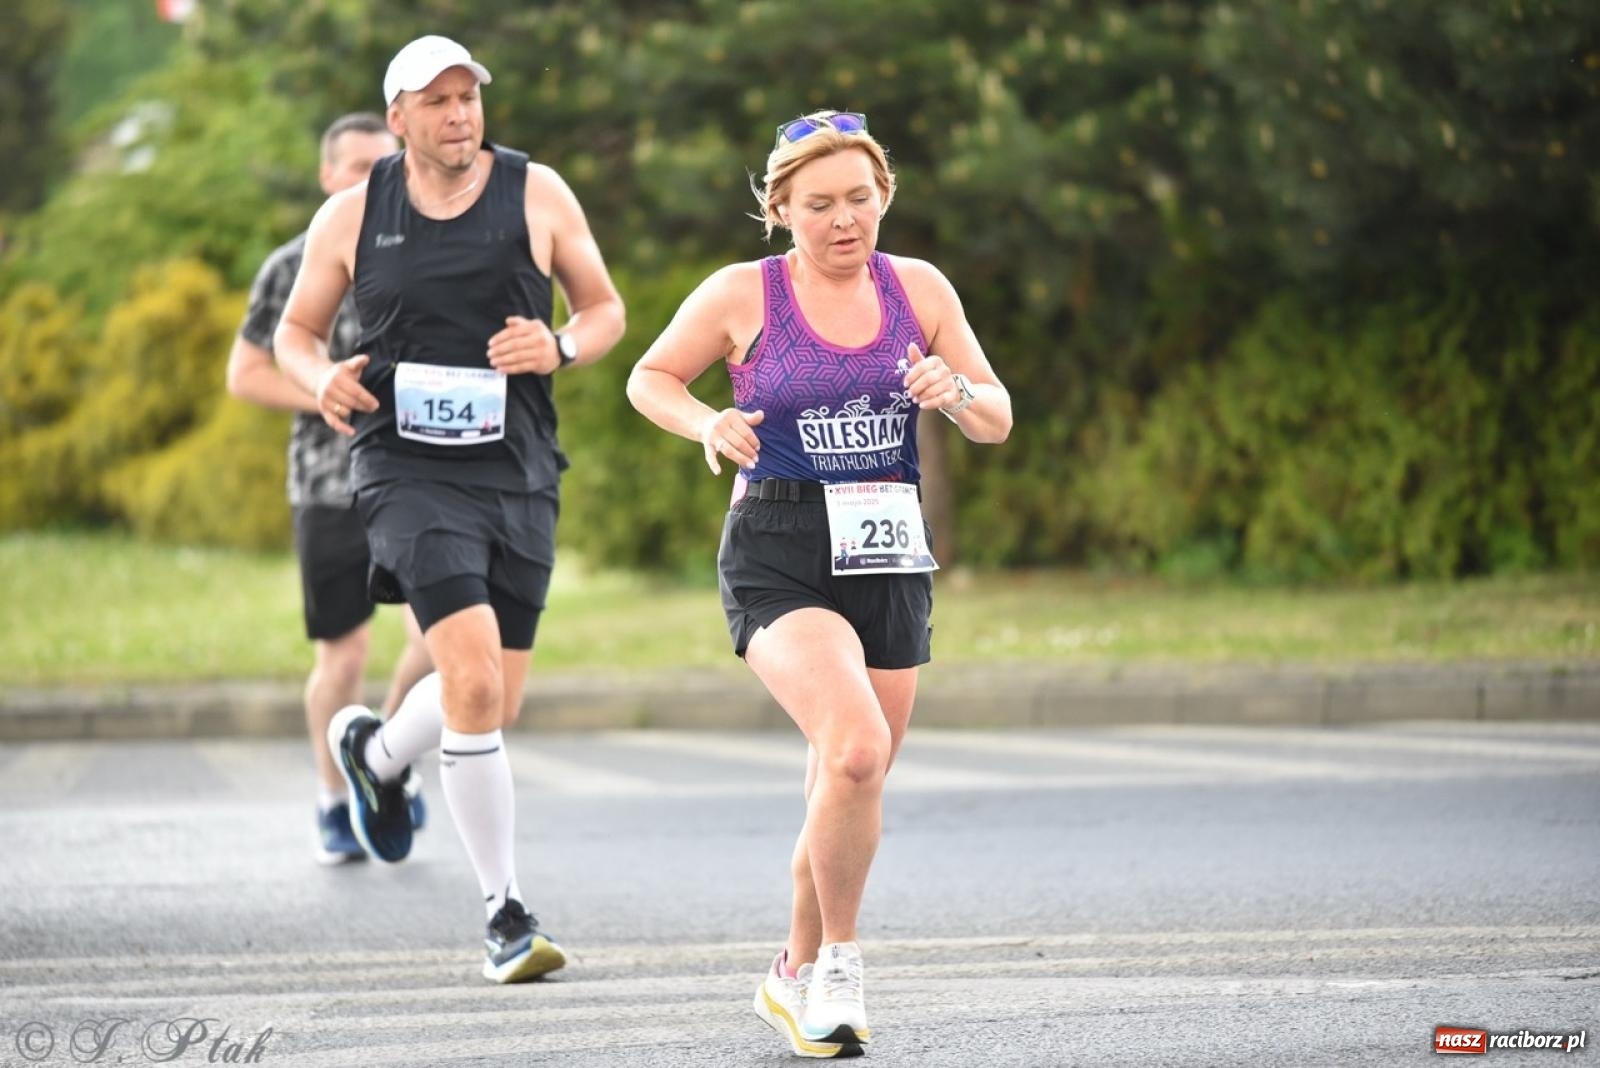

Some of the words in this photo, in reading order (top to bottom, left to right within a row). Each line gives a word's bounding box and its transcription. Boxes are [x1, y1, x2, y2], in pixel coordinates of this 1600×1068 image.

[423, 397, 477, 423] 154
[802, 416, 904, 450] SILESIAN
[810, 452, 880, 471] TRIATHLON
[856, 484, 878, 494] BIEG
[860, 518, 910, 549] 236
